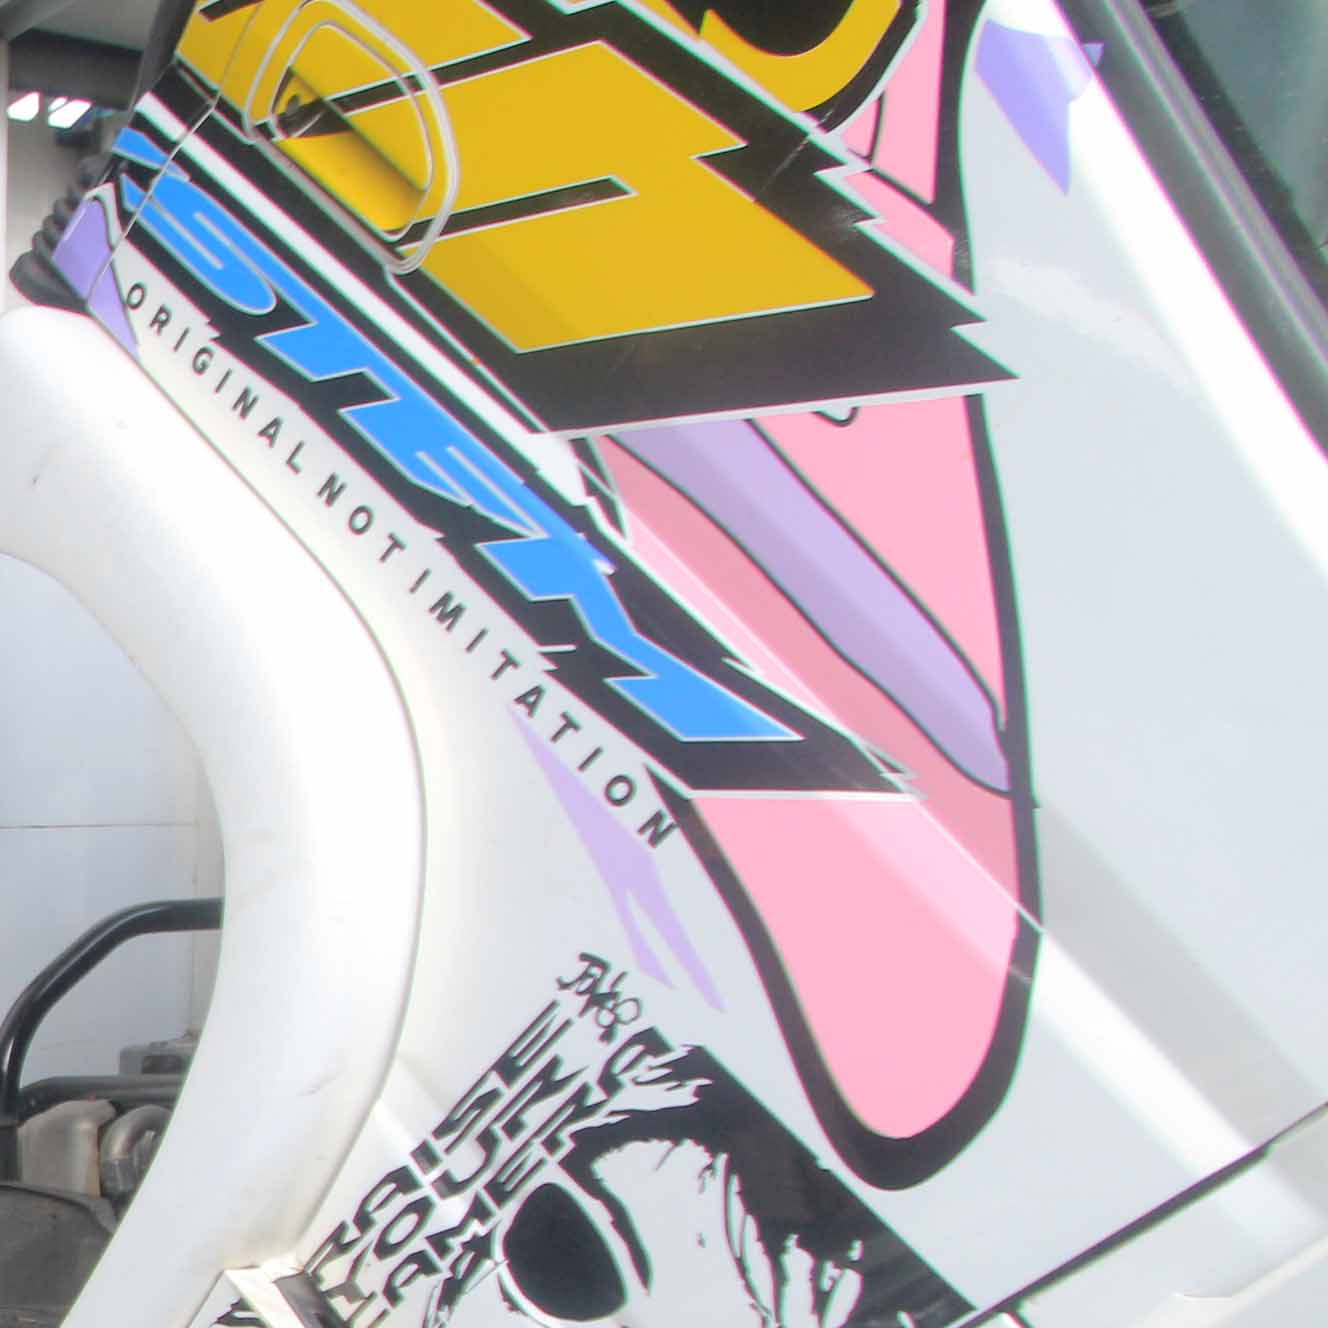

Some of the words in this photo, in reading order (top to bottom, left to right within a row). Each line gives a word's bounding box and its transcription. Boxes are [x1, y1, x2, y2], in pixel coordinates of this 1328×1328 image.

[124, 281, 305, 475] ORIGINAL
[317, 473, 406, 563] NOT
[408, 568, 680, 850] IMITATION
[304, 1000, 573, 1275] RAISE
[320, 1053, 589, 1302] YOUR
